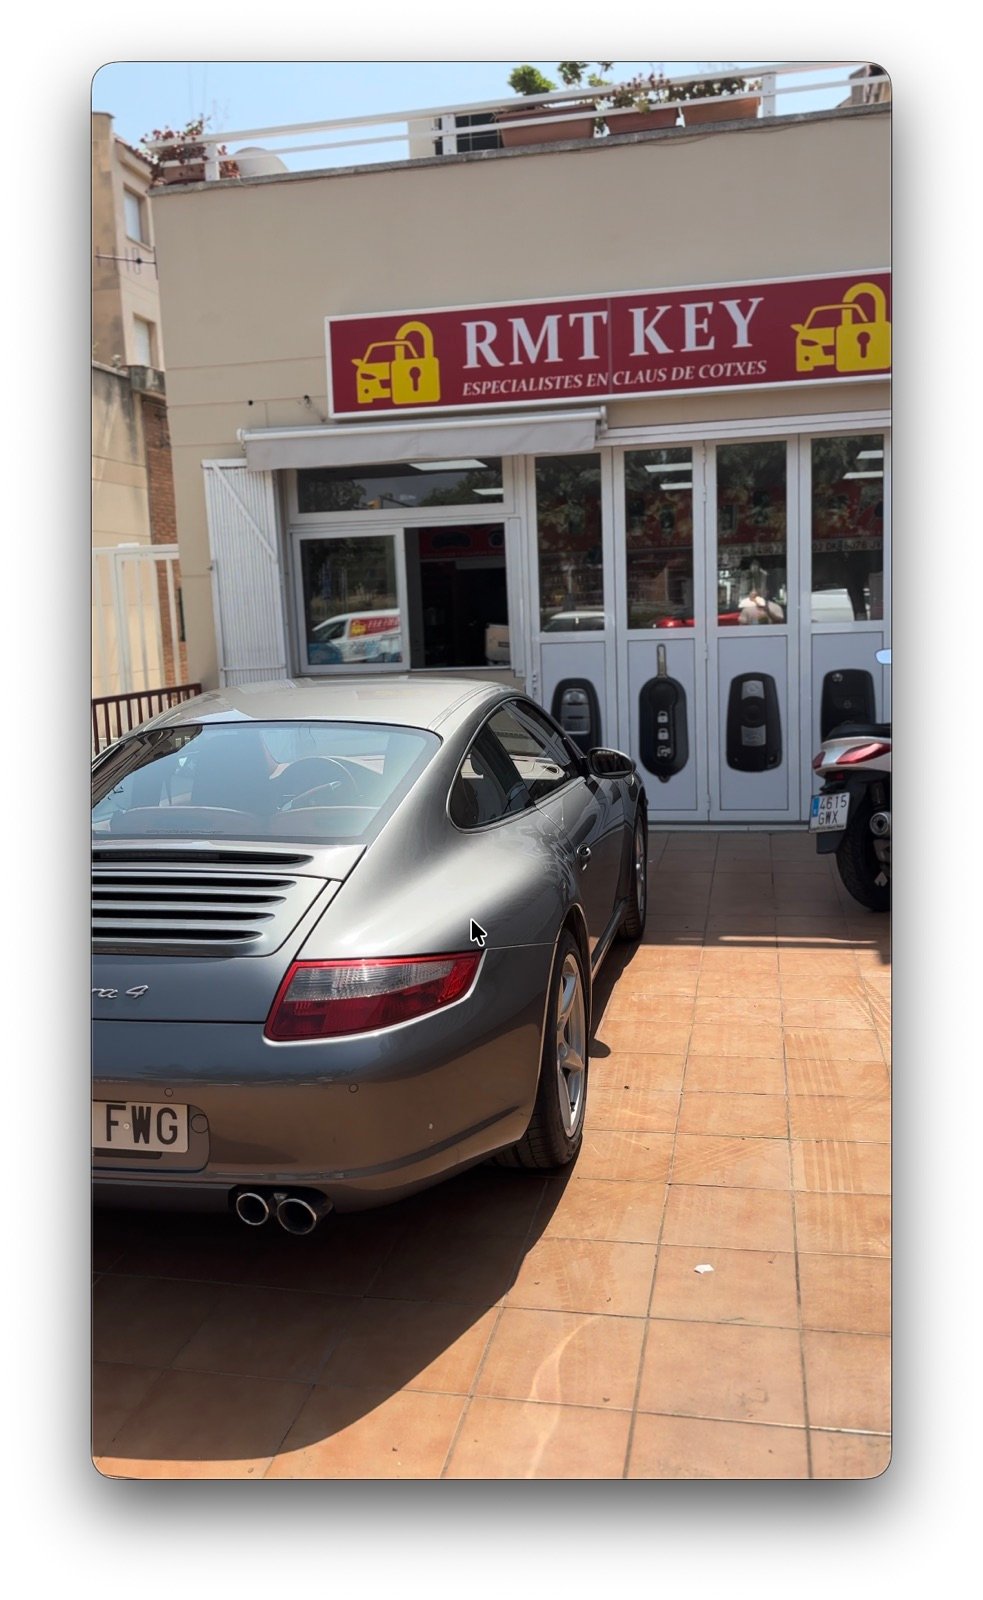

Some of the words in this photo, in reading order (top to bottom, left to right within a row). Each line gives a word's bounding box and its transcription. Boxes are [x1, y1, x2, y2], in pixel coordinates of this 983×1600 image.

[461, 311, 608, 369] RMT
[628, 297, 764, 356] KEY
[462, 374, 583, 396] ESPECIALISTES
[586, 372, 609, 387] EN
[612, 368, 667, 386] CLAUS
[671, 366, 695, 381] DE
[698, 360, 767, 379] COTXES
[820, 794, 847, 810] 4615
[818, 810, 838, 825] GWX
[125, 985, 149, 999] 4
[106, 1104, 178, 1145] FWG
